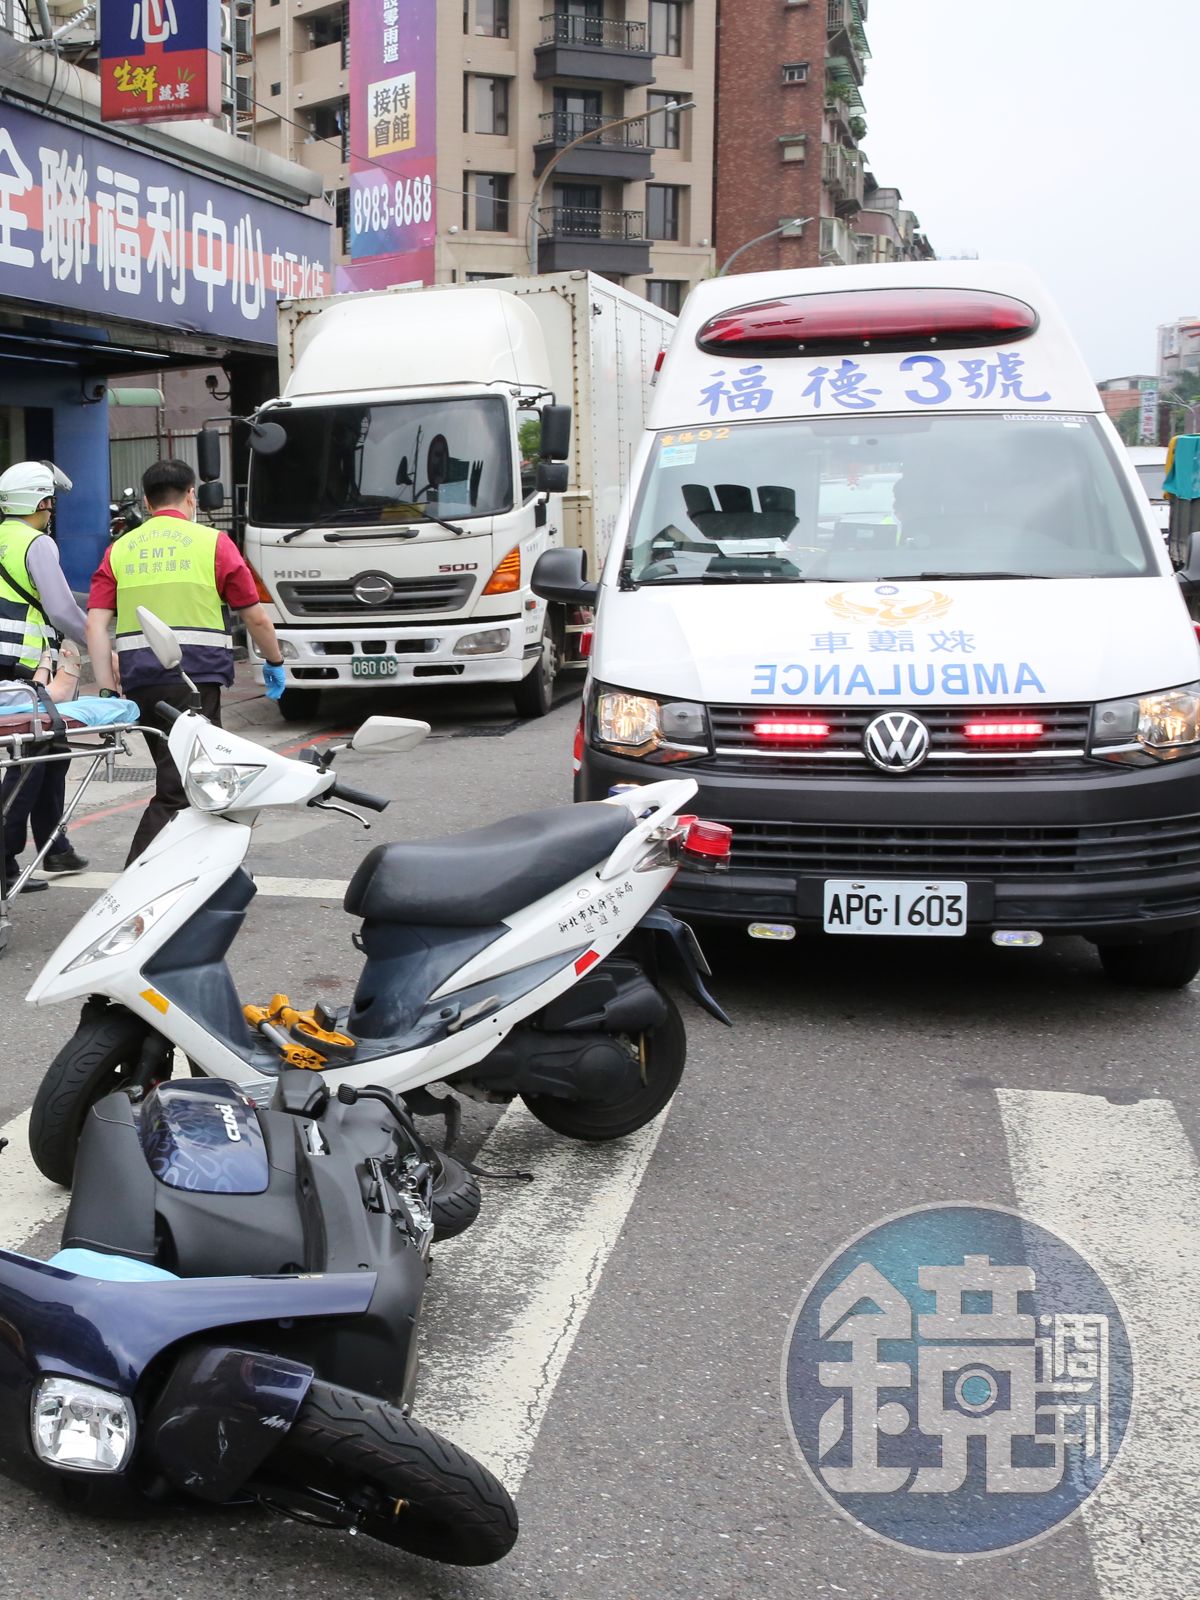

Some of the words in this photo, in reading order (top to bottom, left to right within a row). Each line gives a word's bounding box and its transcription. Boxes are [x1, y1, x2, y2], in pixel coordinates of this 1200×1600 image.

[113, 60, 158, 103] 生鮮
[373, 83, 410, 118] 接待
[373, 114, 410, 148] 會館
[354, 174, 432, 234] 8983-8688
[697, 351, 1051, 416] 福德3號
[140, 546, 177, 559] EMT
[438, 562, 478, 573] 500
[274, 569, 321, 579] HINO
[828, 893, 963, 927] APG-1603
